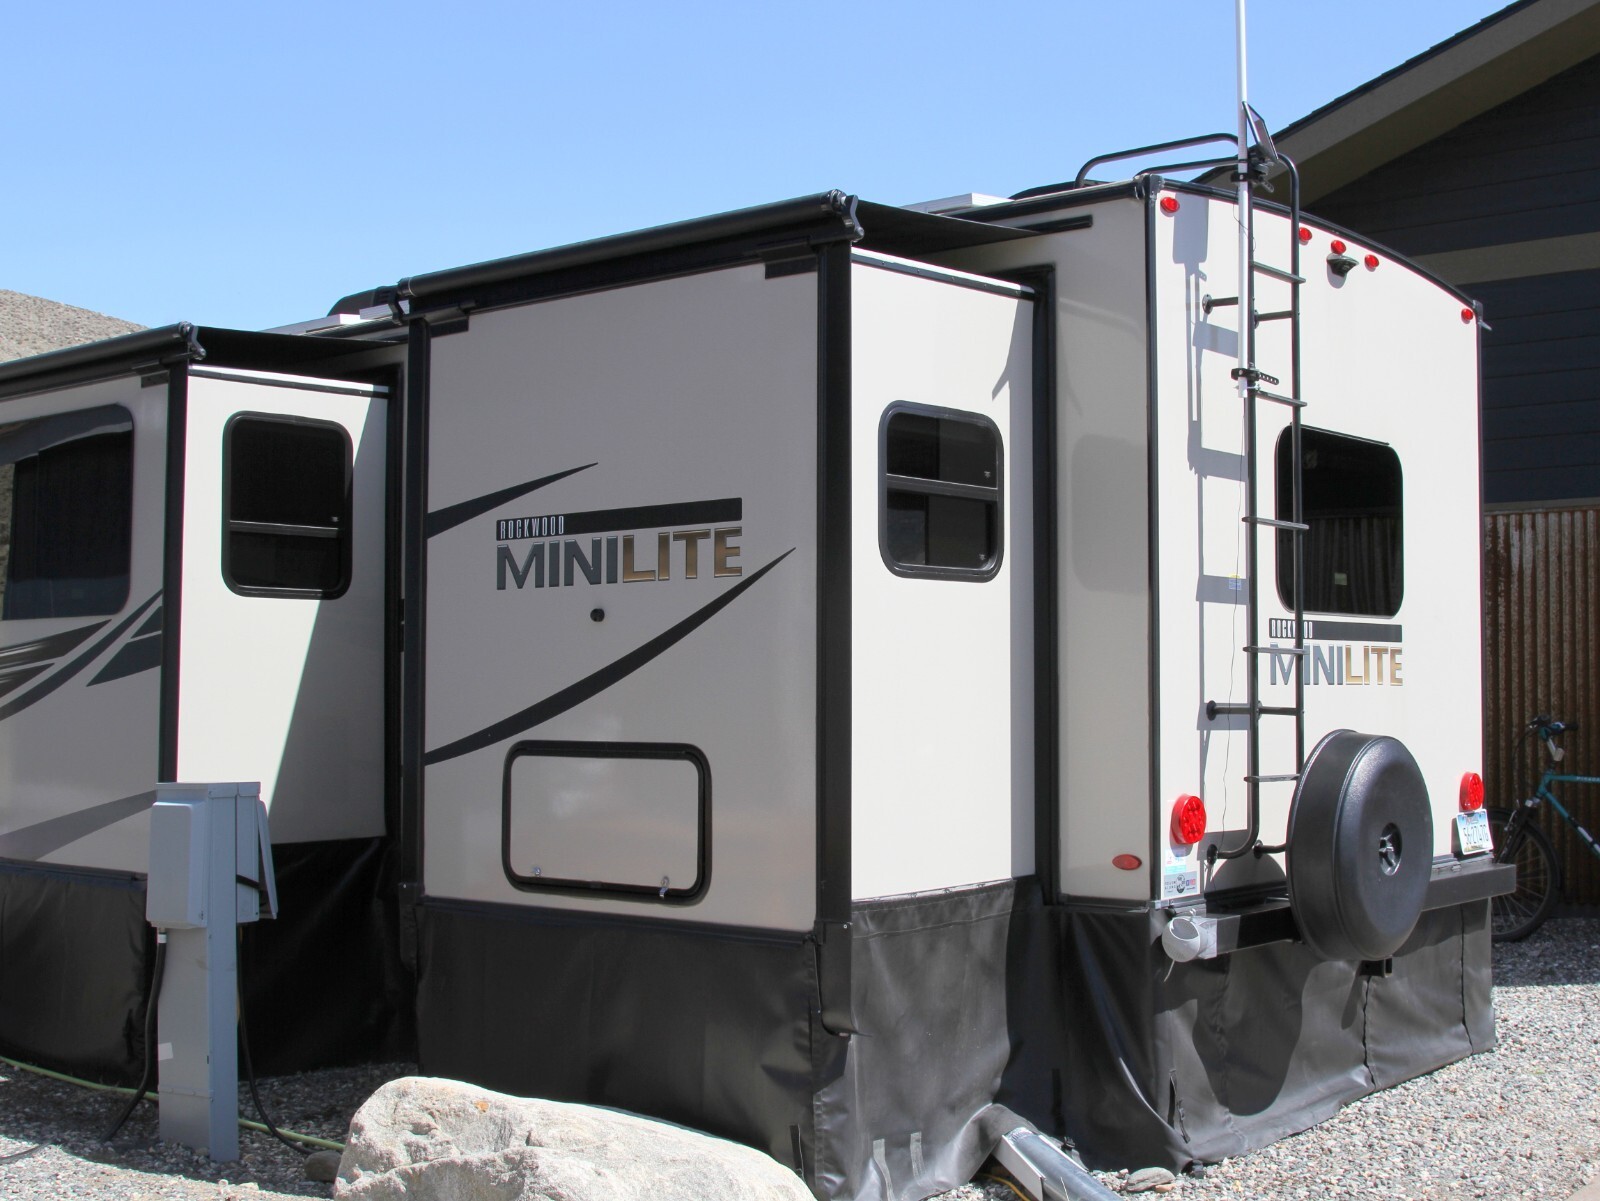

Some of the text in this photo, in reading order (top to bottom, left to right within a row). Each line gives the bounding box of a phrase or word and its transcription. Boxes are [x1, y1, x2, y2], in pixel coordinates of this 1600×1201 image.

[500, 515, 565, 540] ROCKWOOD
[496, 526, 743, 590] MINILITE
[1271, 619, 1313, 639] ROCKOD
